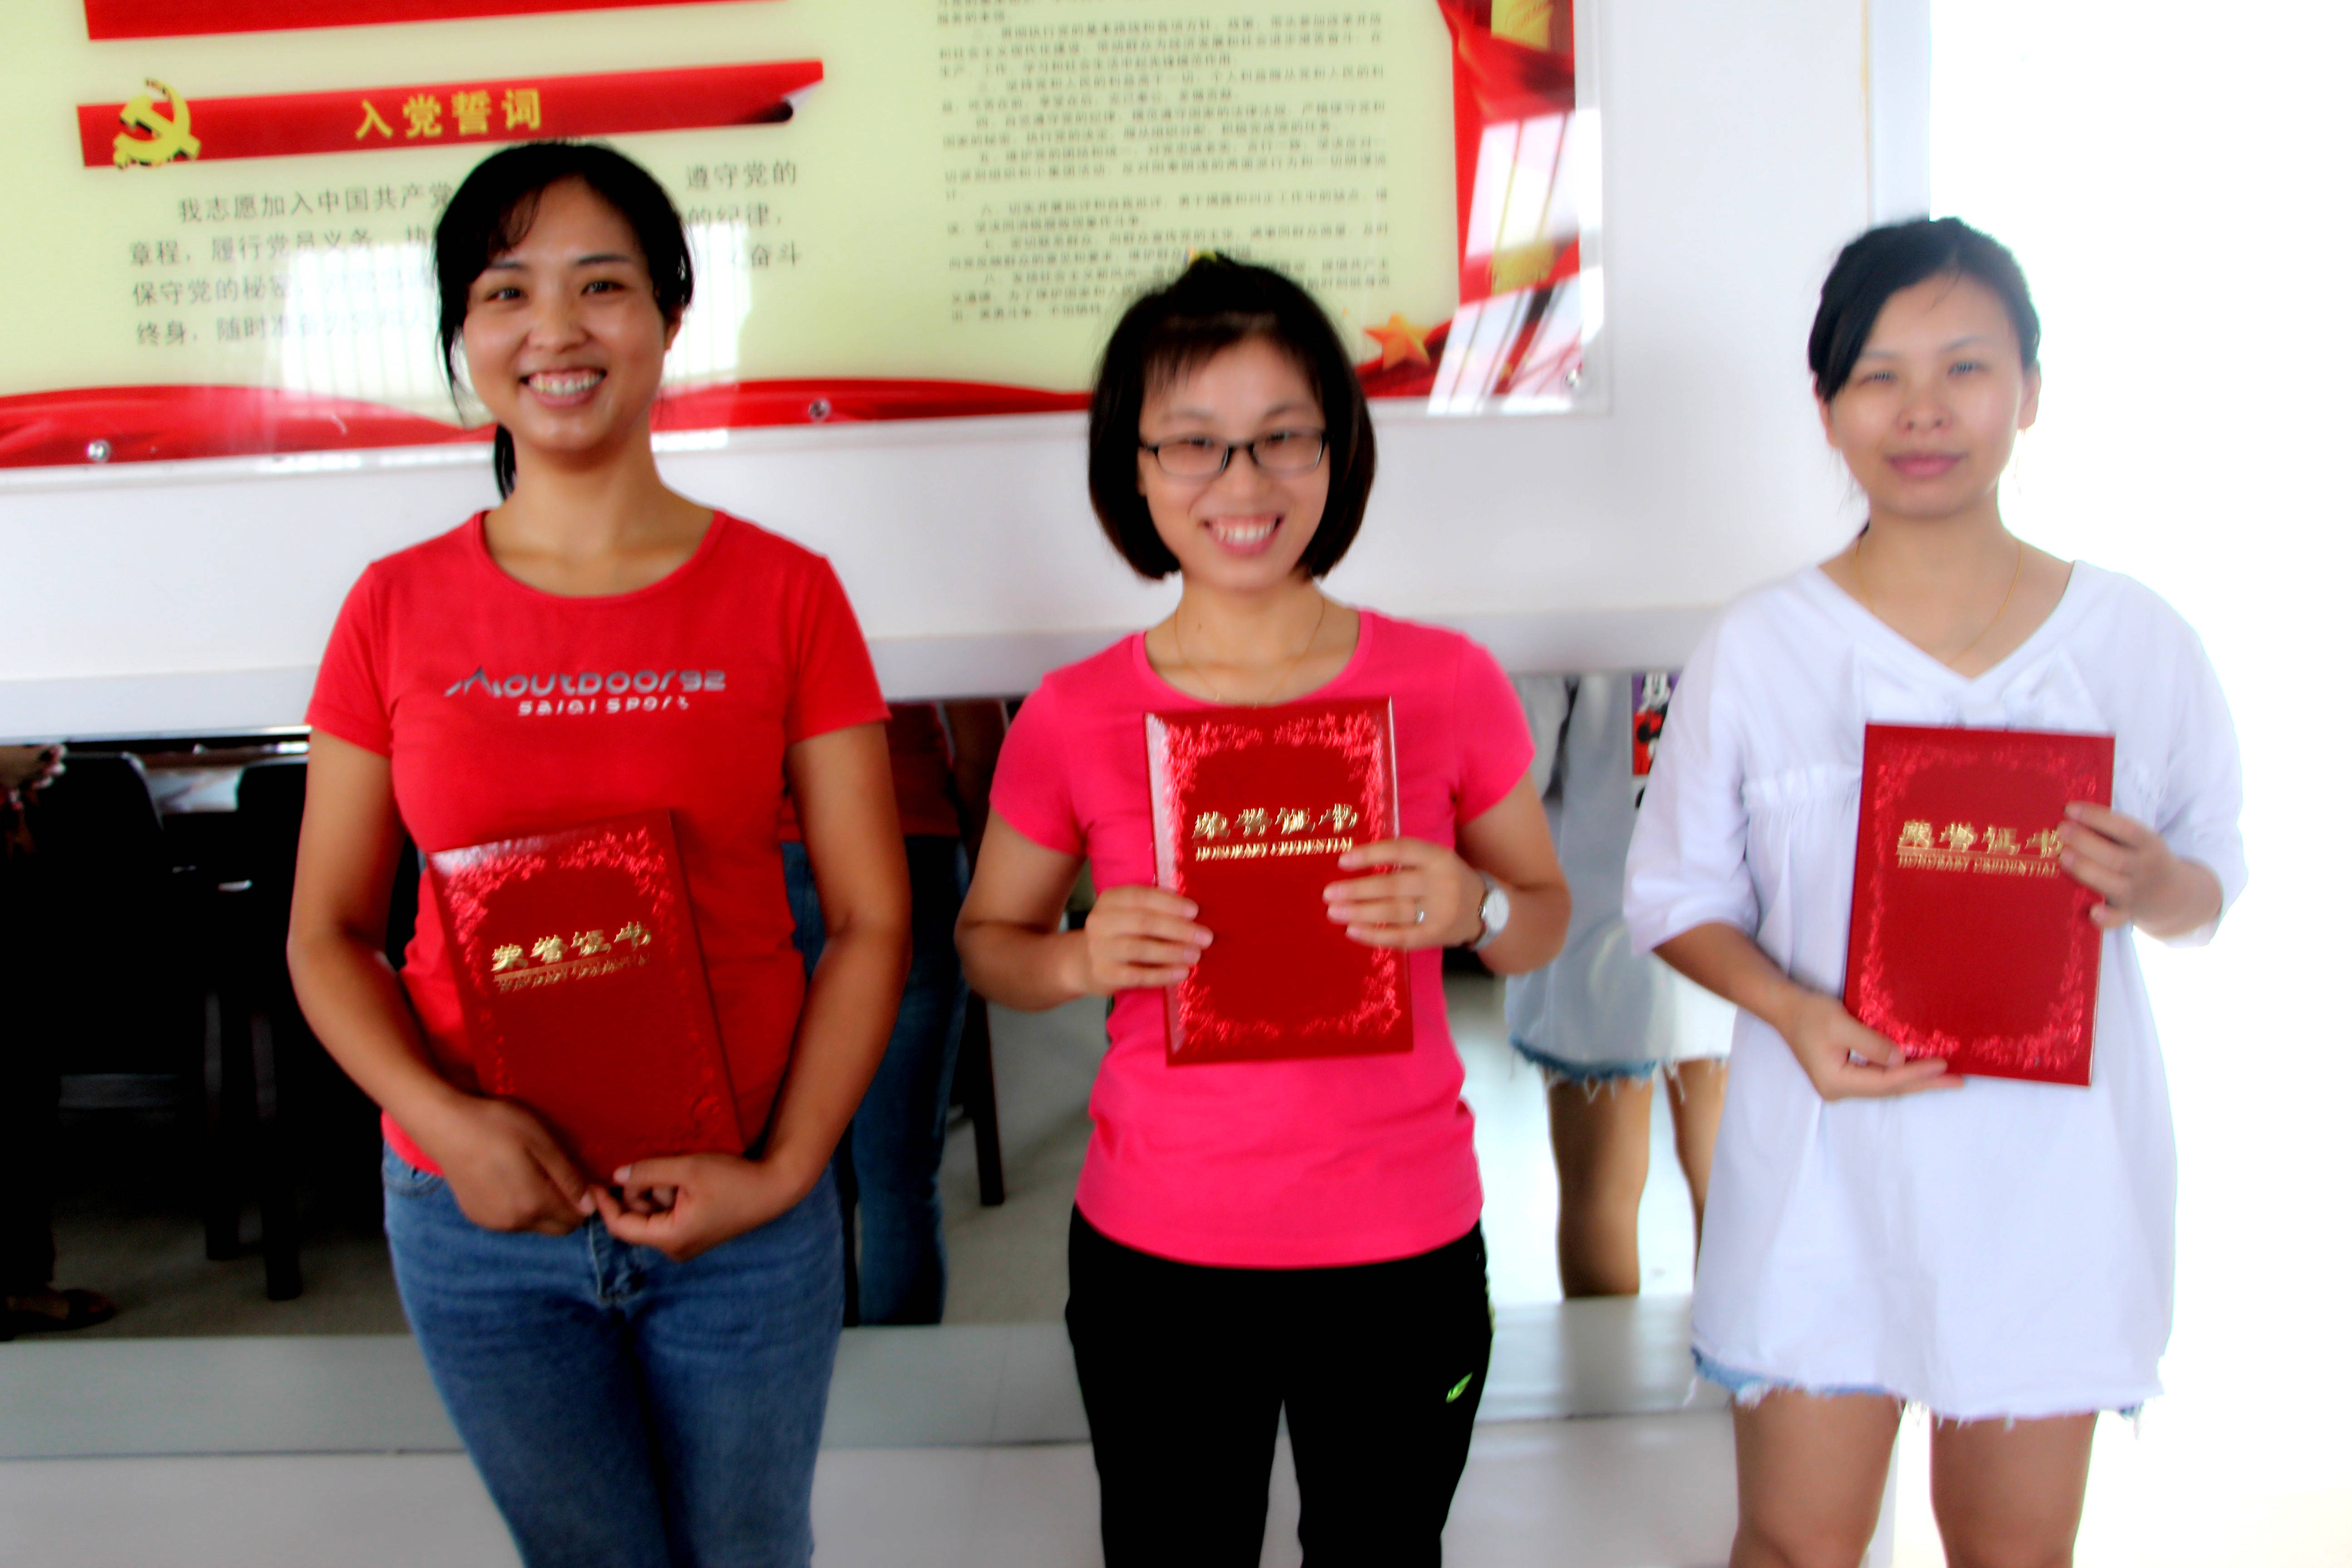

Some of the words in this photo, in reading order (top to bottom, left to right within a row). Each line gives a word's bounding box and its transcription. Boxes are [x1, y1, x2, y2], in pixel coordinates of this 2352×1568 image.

[356, 88, 540, 139] 入党誓词
[178, 181, 452, 223] 我志愿加入中国共产党
